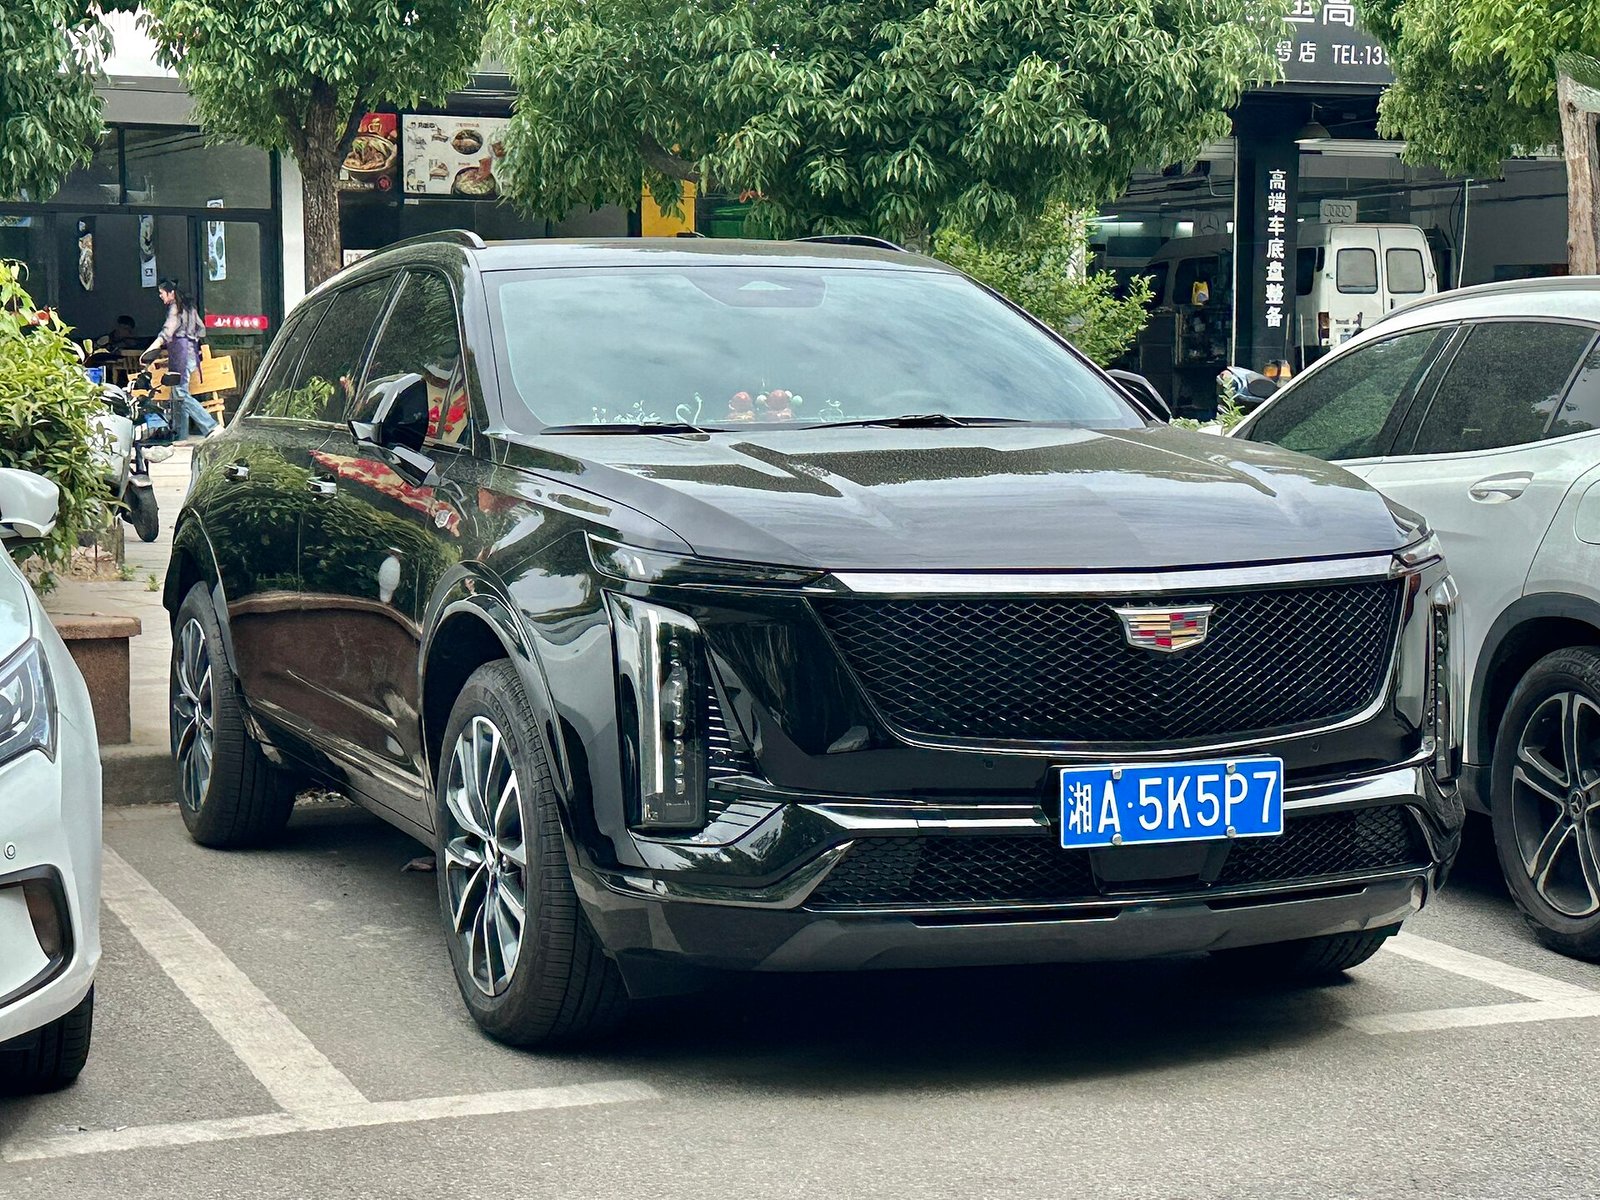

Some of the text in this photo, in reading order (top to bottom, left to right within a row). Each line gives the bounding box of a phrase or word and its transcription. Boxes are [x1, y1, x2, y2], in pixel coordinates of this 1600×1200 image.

[1265, 169, 1287, 328] 高端车底盘整备
[1067, 770, 1278, 835] 湘A·5K5P7
